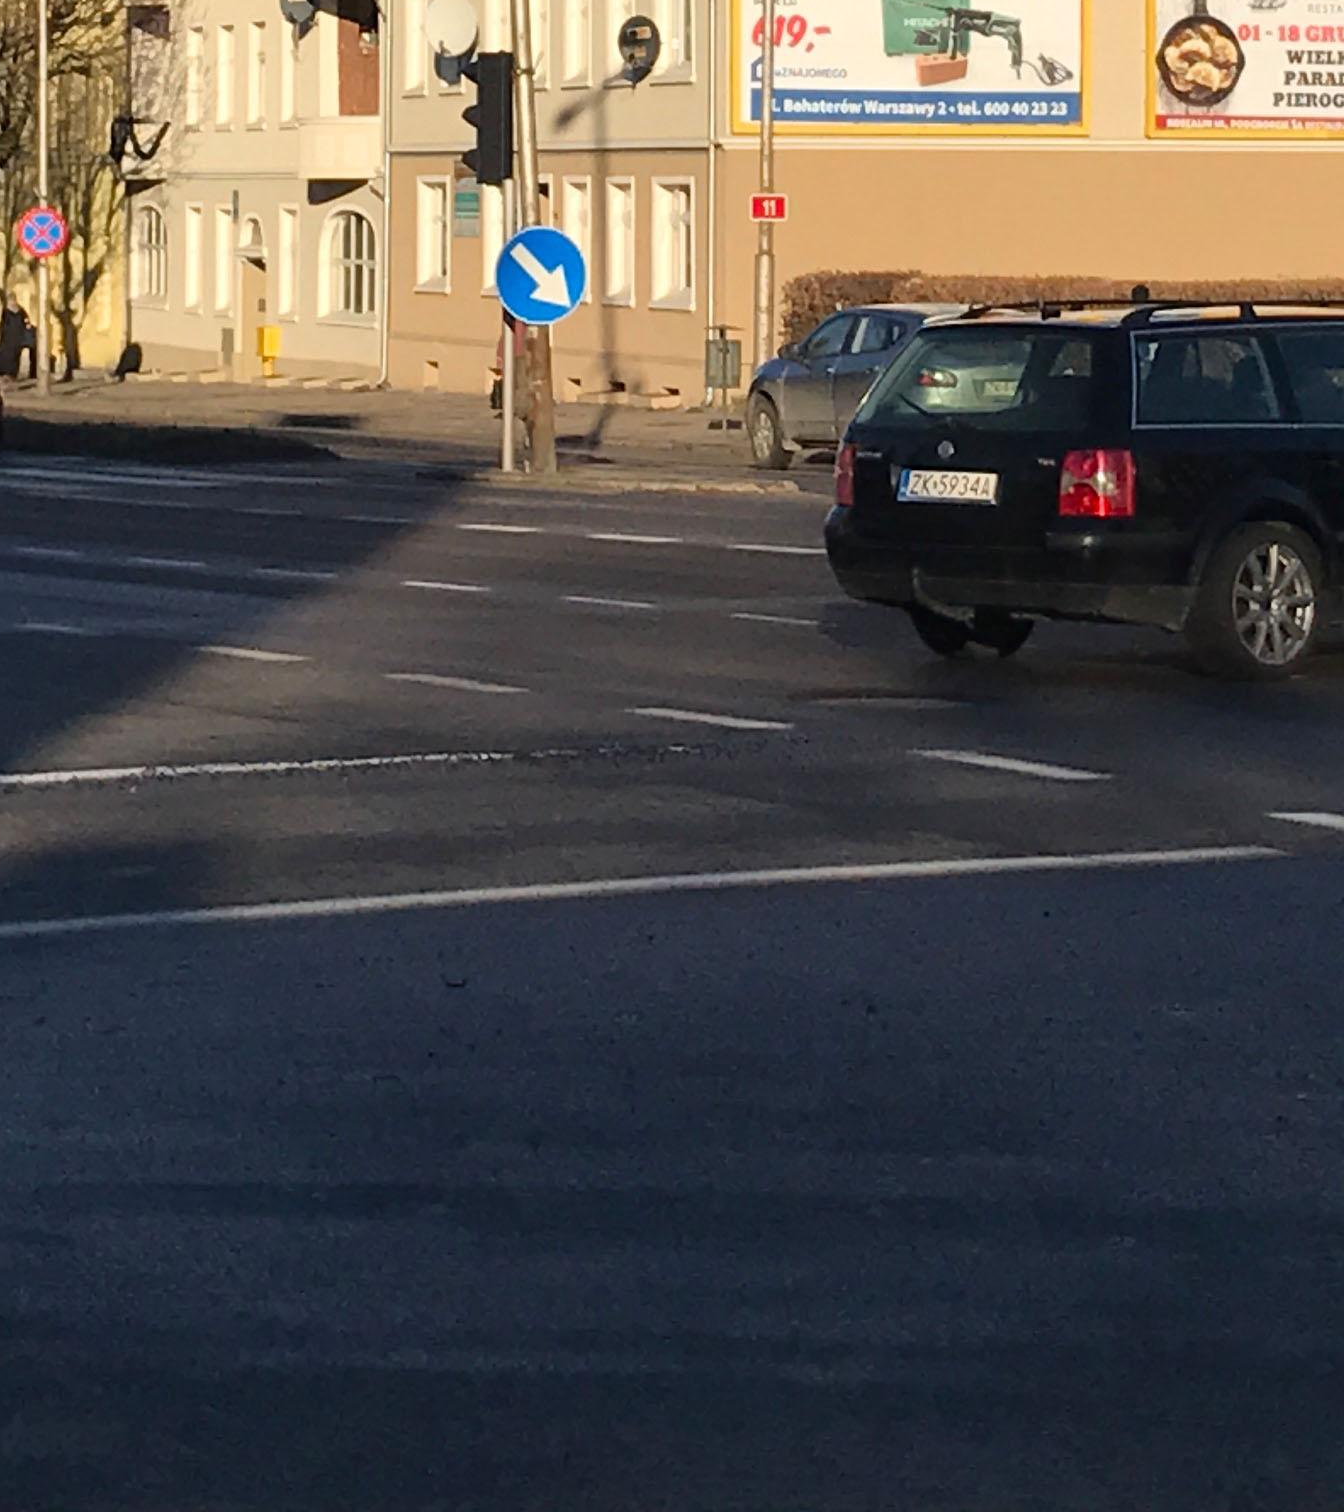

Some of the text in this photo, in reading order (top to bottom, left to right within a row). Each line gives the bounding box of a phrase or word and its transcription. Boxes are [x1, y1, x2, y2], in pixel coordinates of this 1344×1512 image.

[1237, 24, 1261, 42] 01
[1277, 24, 1301, 42] 18
[783, 97, 862, 114] Bohaterów
[863, 99, 936, 119] Warszawy
[937, 101, 947, 116] 2
[956, 100, 982, 116] tel.
[984, 101, 1009, 117] 600
[1011, 101, 1029, 117] 40
[1031, 101, 1048, 117] 23
[1050, 101, 1068, 117] 23
[762, 199, 776, 217] 11
